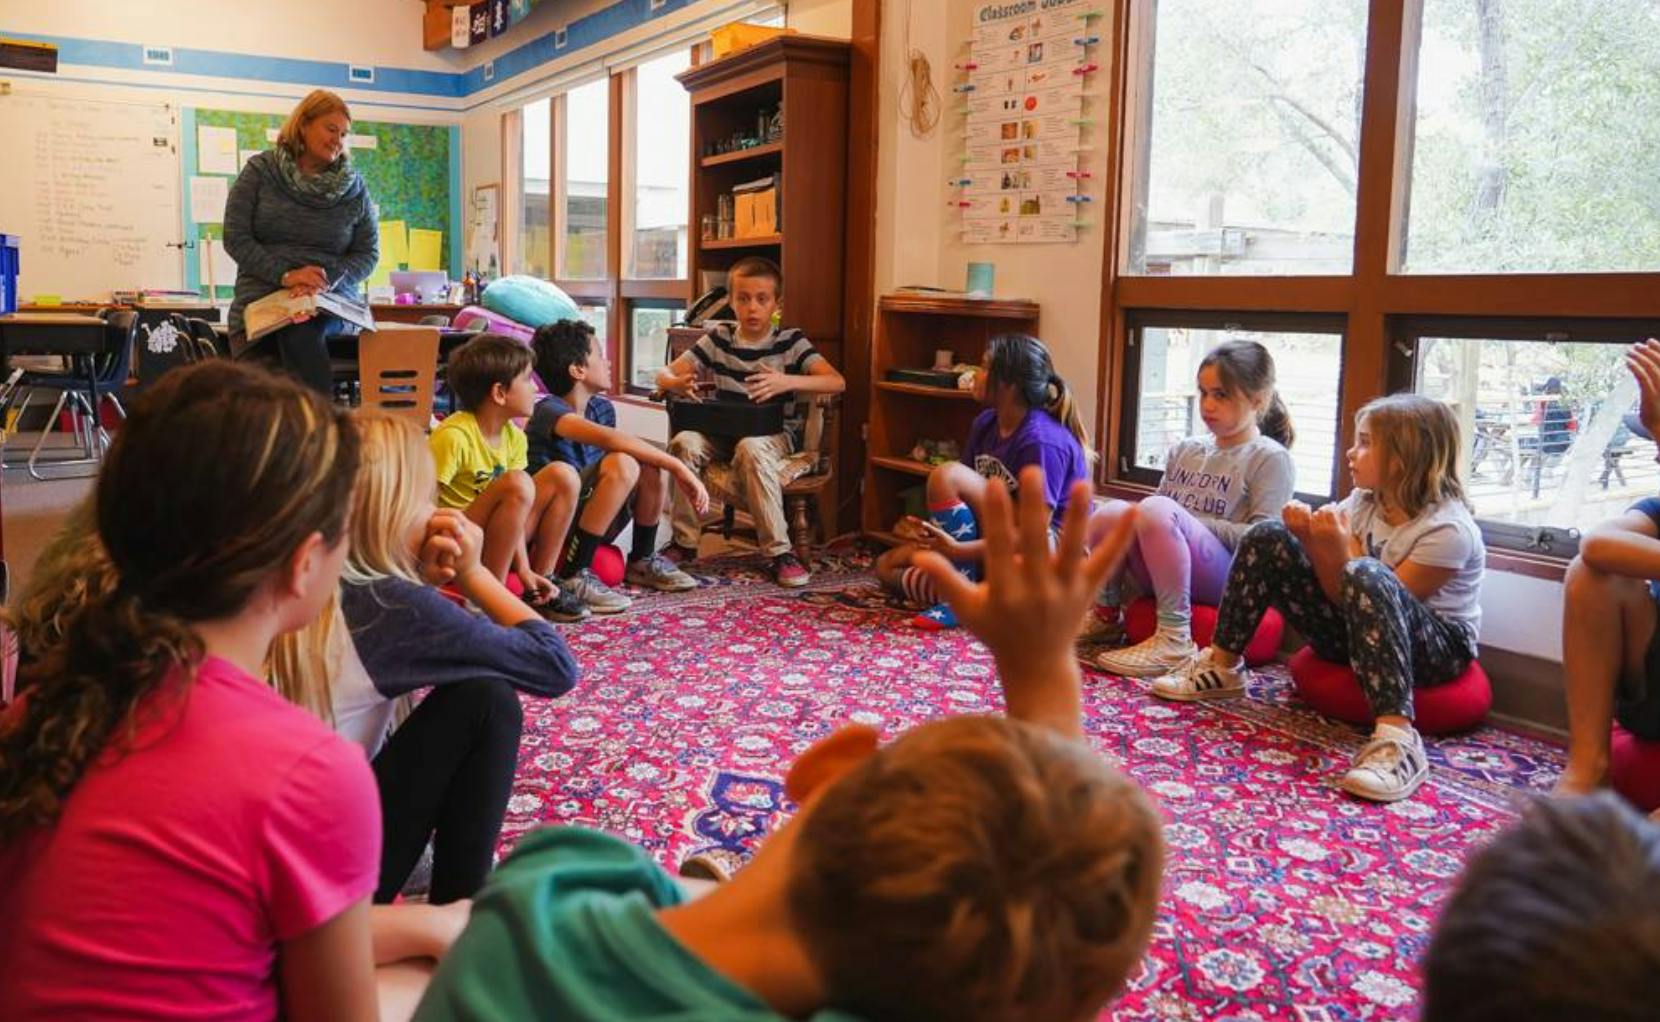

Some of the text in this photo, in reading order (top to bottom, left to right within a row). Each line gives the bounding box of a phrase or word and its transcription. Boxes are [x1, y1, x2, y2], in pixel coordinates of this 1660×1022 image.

[979, 1, 1037, 21] Classroom
[1167, 466, 1231, 493] UNICORN
[1183, 493, 1227, 515] CLUB
